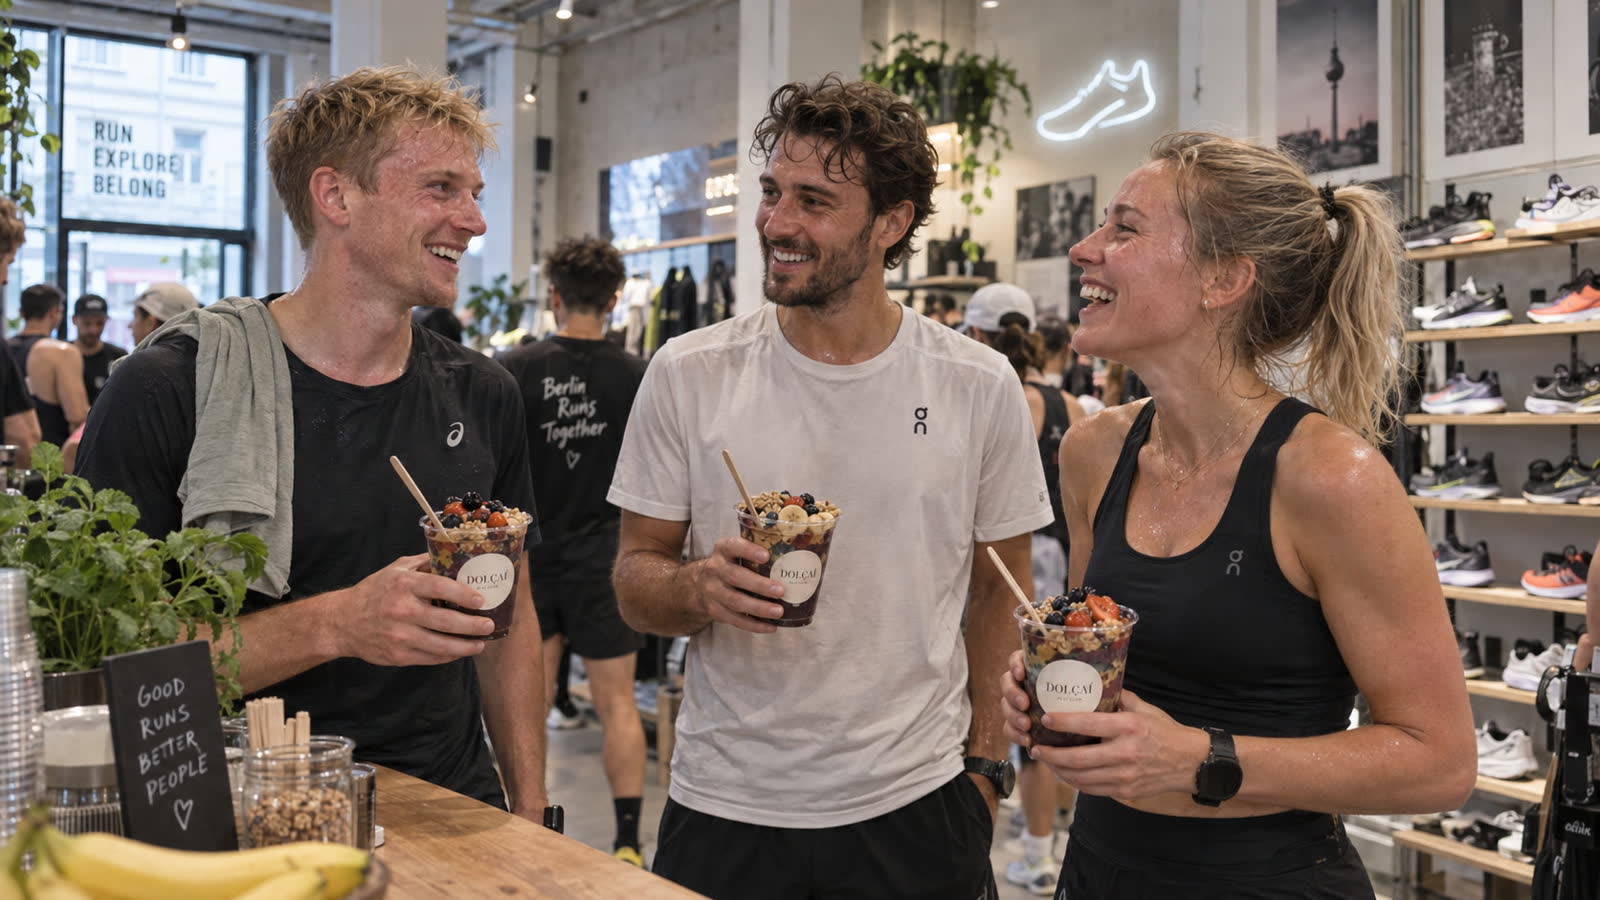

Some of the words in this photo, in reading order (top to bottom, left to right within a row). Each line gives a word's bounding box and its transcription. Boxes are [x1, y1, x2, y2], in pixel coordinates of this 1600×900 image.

[95, 120, 132, 142] RUN
[94, 147, 178, 174] EXPLORE
[94, 175, 165, 198] BELONG
[541, 375, 586, 400] Berlin
[557, 396, 597, 418] Runs
[541, 418, 608, 449] Together
[137, 678, 185, 707] GOOD
[140, 703, 190, 740] RUNS
[138, 730, 201, 775] BETTER
[146, 752, 208, 805] PEOPLE
